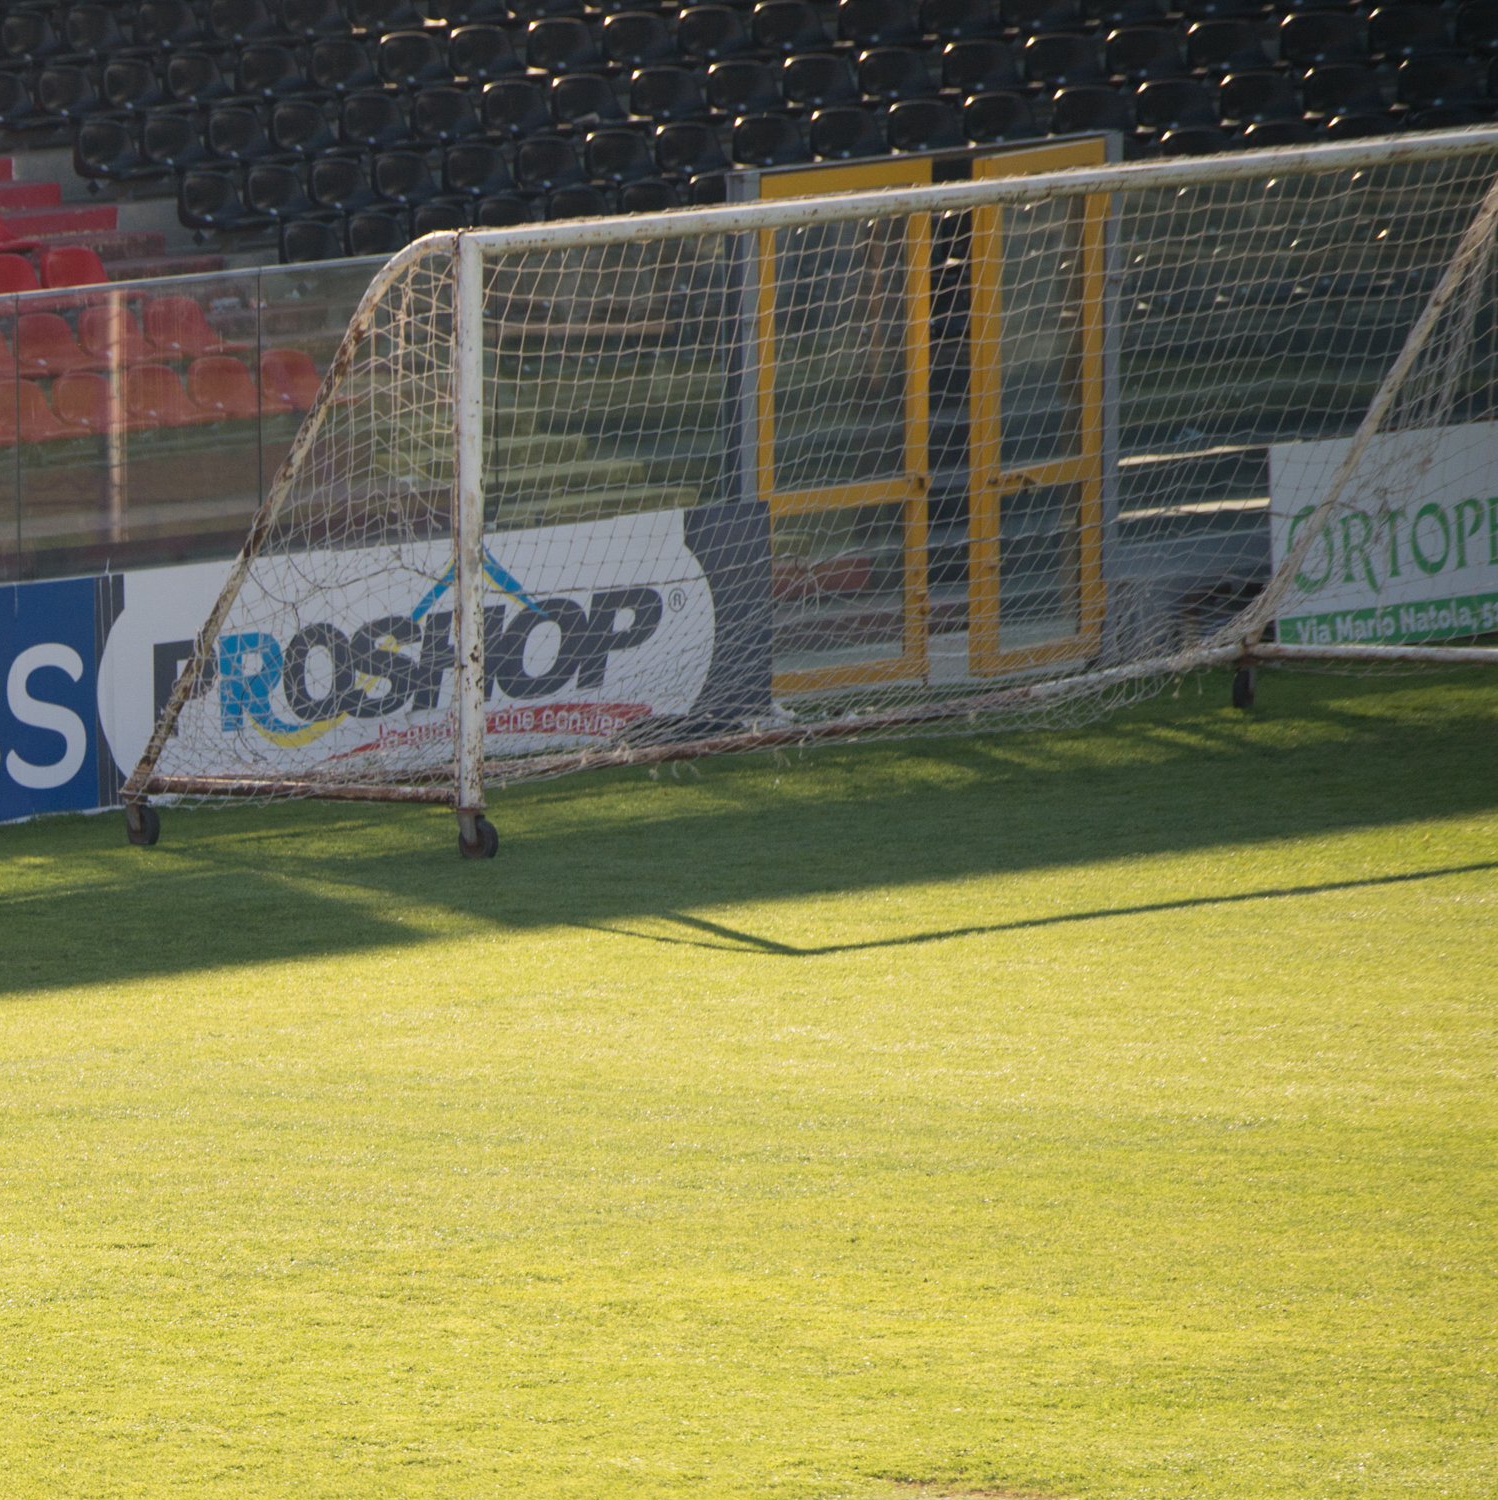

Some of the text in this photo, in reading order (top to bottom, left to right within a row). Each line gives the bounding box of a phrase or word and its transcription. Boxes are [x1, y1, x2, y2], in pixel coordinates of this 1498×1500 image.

[1296, 618, 1332, 645] Via
[1335, 608, 1396, 642] Mario
[542, 706, 628, 738] convien
